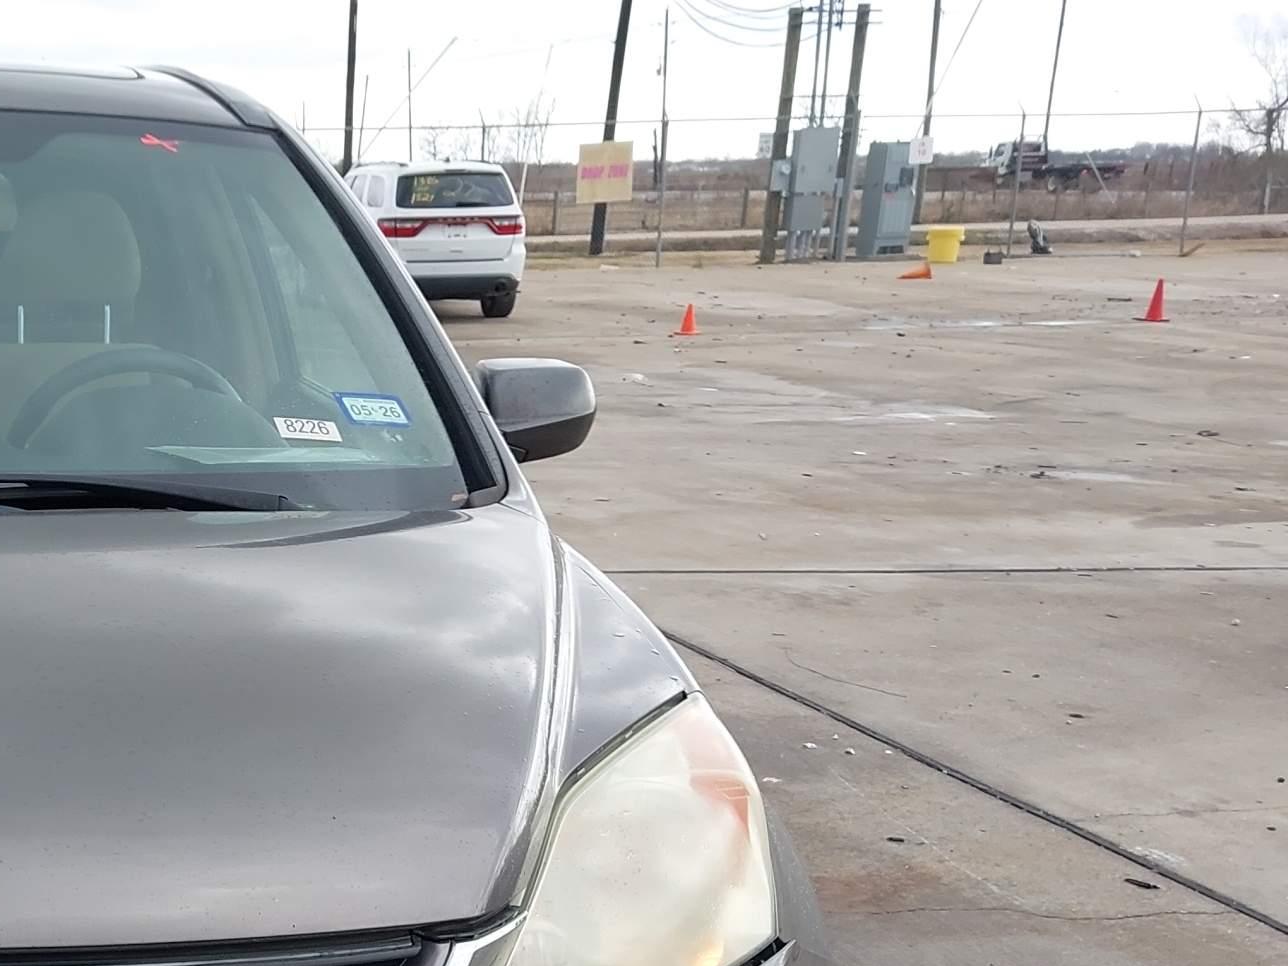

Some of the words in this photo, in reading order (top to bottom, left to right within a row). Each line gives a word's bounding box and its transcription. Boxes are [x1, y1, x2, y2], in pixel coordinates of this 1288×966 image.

[350, 404, 372, 416] 05
[379, 405, 401, 418] 26
[283, 418, 330, 436] 8226
